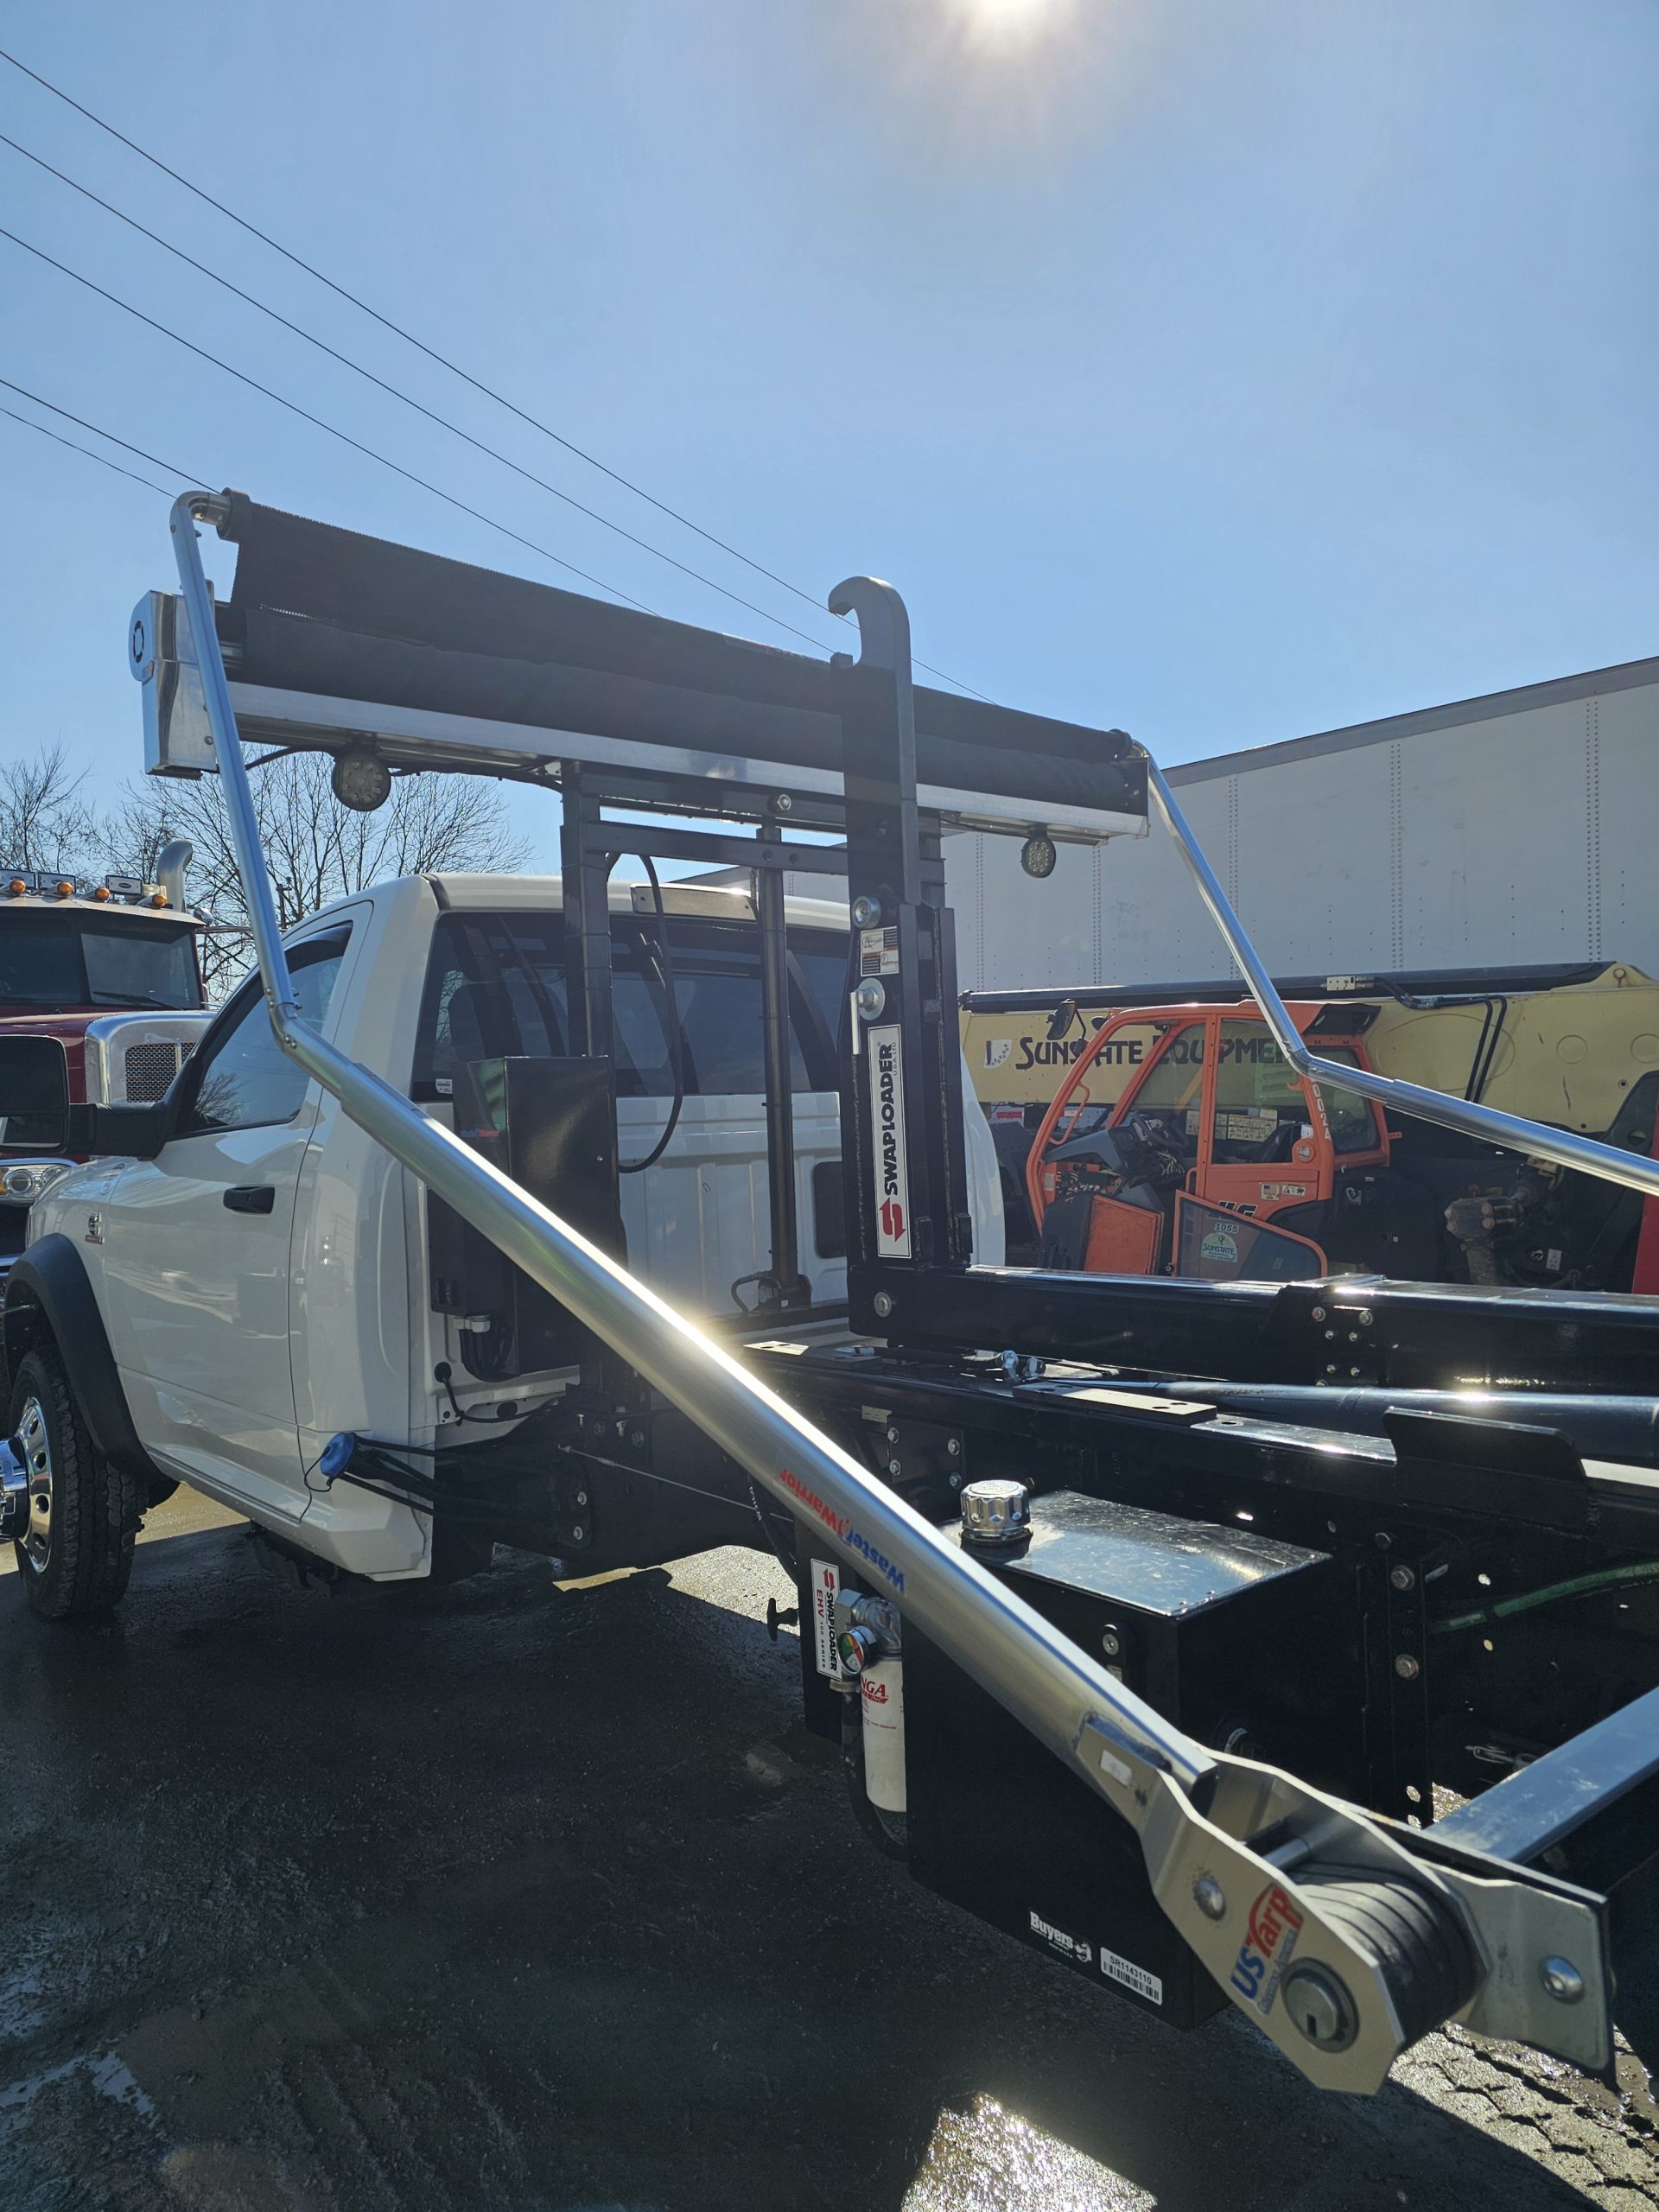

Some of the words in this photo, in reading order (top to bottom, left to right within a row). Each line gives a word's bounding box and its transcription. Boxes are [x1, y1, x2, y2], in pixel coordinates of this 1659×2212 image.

[879, 1043, 898, 1196] SWAPLOADER
[1215, 1223, 1238, 1233] 1055
[779, 1468, 837, 1532] Warrior
[826, 1592, 838, 1672] SWAPLOADER
[1030, 1910, 1074, 1949] Buyers
[1109, 1955, 1153, 1986] SR1143110
